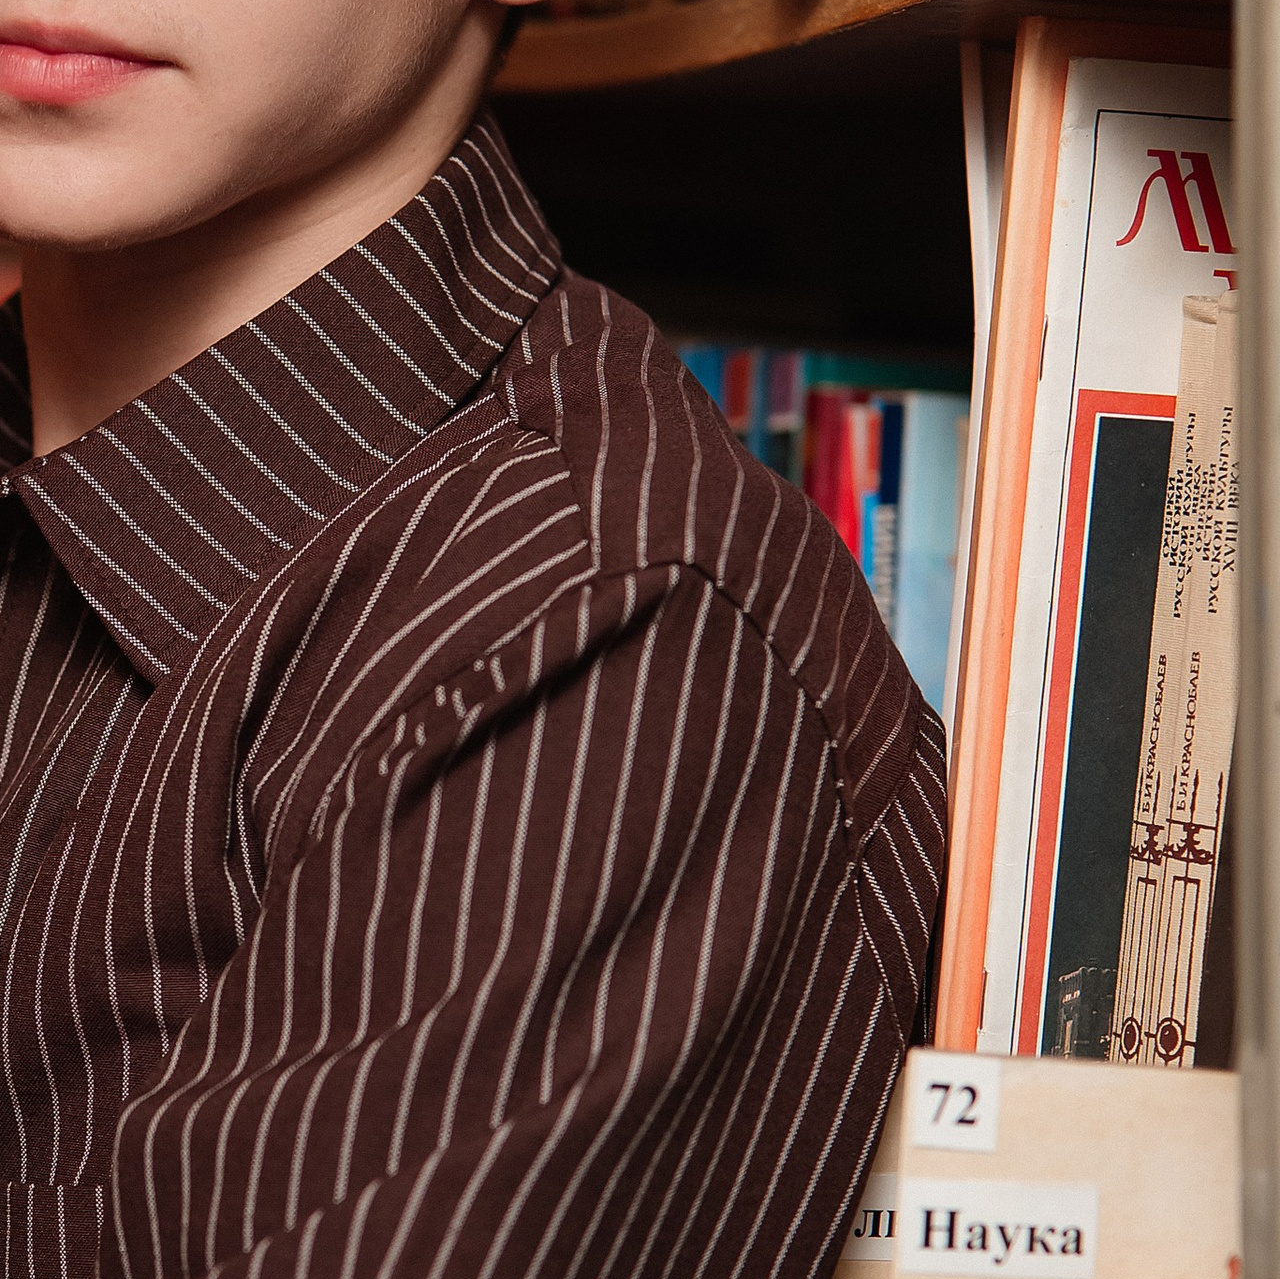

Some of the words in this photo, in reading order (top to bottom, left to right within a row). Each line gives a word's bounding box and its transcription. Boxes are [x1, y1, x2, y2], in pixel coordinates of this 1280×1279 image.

[1183, 412, 1196, 516] КУЛЬТУРЫ
[1192, 464, 1201, 513] ВЕКА
[1215, 406, 1234, 511] КУЛЬТУРЫ
[1227, 461, 1241, 509] ВЕКА
[1162, 477, 1176, 558] ОЧЕРКИ
[1170, 469, 1184, 567] ИСТОРИИ
[1195, 471, 1208, 553] ОЧЕРКИ
[1202, 463, 1216, 561] ИСТОРИИ
[1145, 654, 1167, 781] КРАСНОБАЕВ
[1181, 651, 1201, 778] КРАСНОБАЕВ
[928, 1083, 979, 1126] 72
[920, 1208, 1085, 1265] Наука
